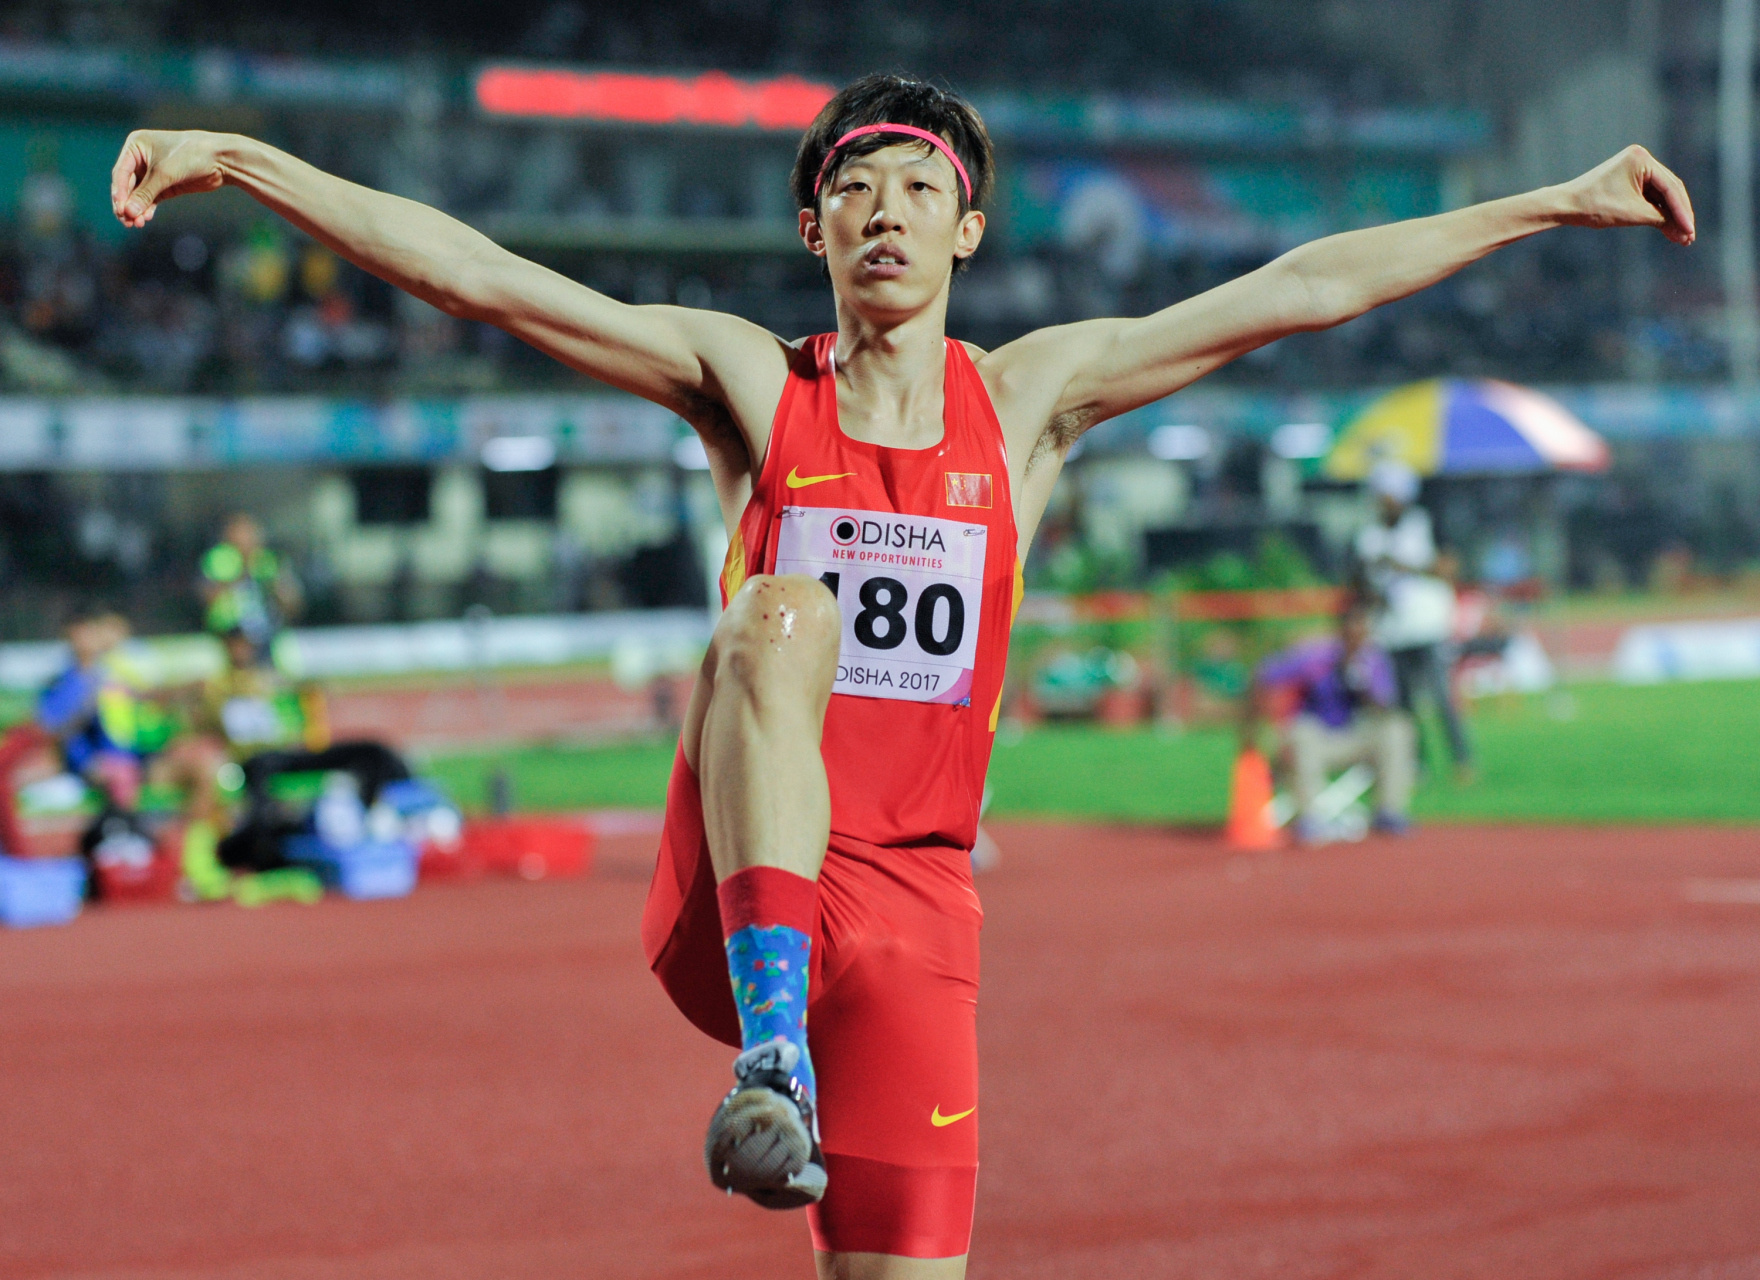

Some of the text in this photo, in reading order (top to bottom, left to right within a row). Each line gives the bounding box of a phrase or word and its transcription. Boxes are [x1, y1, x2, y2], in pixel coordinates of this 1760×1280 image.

[830, 515, 946, 552] ODISHA
[832, 549, 943, 569] NEW OPPORTUNITIES
[899, 672, 940, 691] 2017
